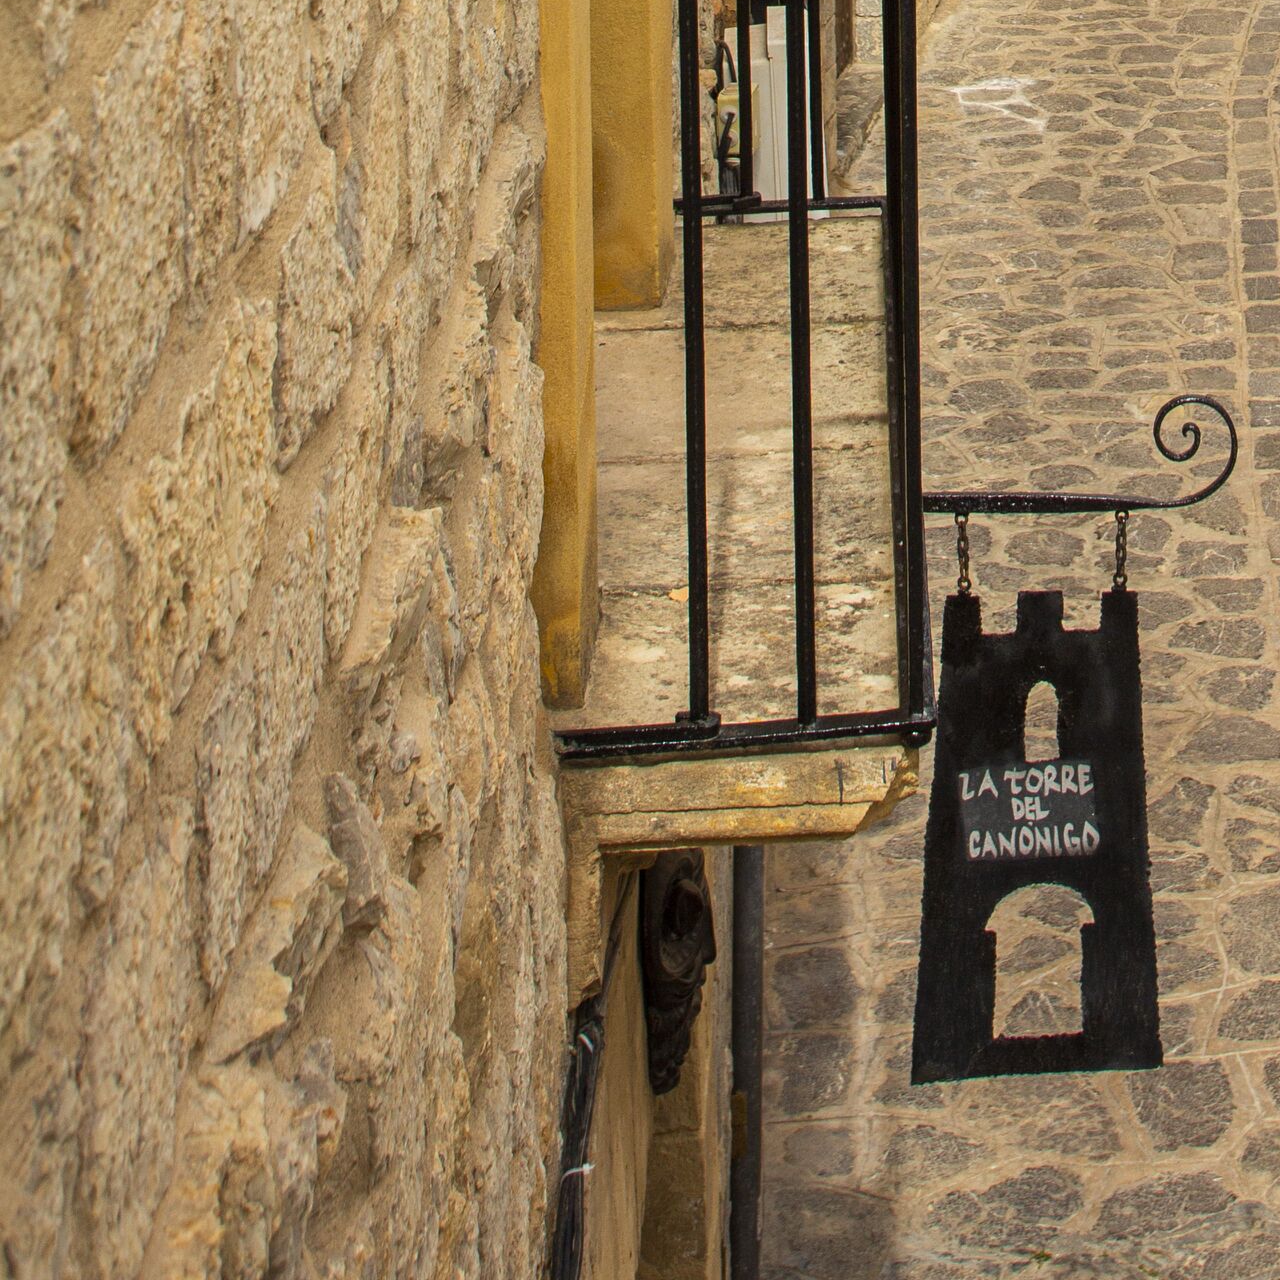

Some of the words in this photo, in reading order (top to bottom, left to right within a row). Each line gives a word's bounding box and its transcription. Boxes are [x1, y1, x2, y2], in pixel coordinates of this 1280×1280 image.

[958, 769, 998, 801] LA
[1003, 764, 1094, 797] TORRE
[1011, 796, 1050, 821] DEL
